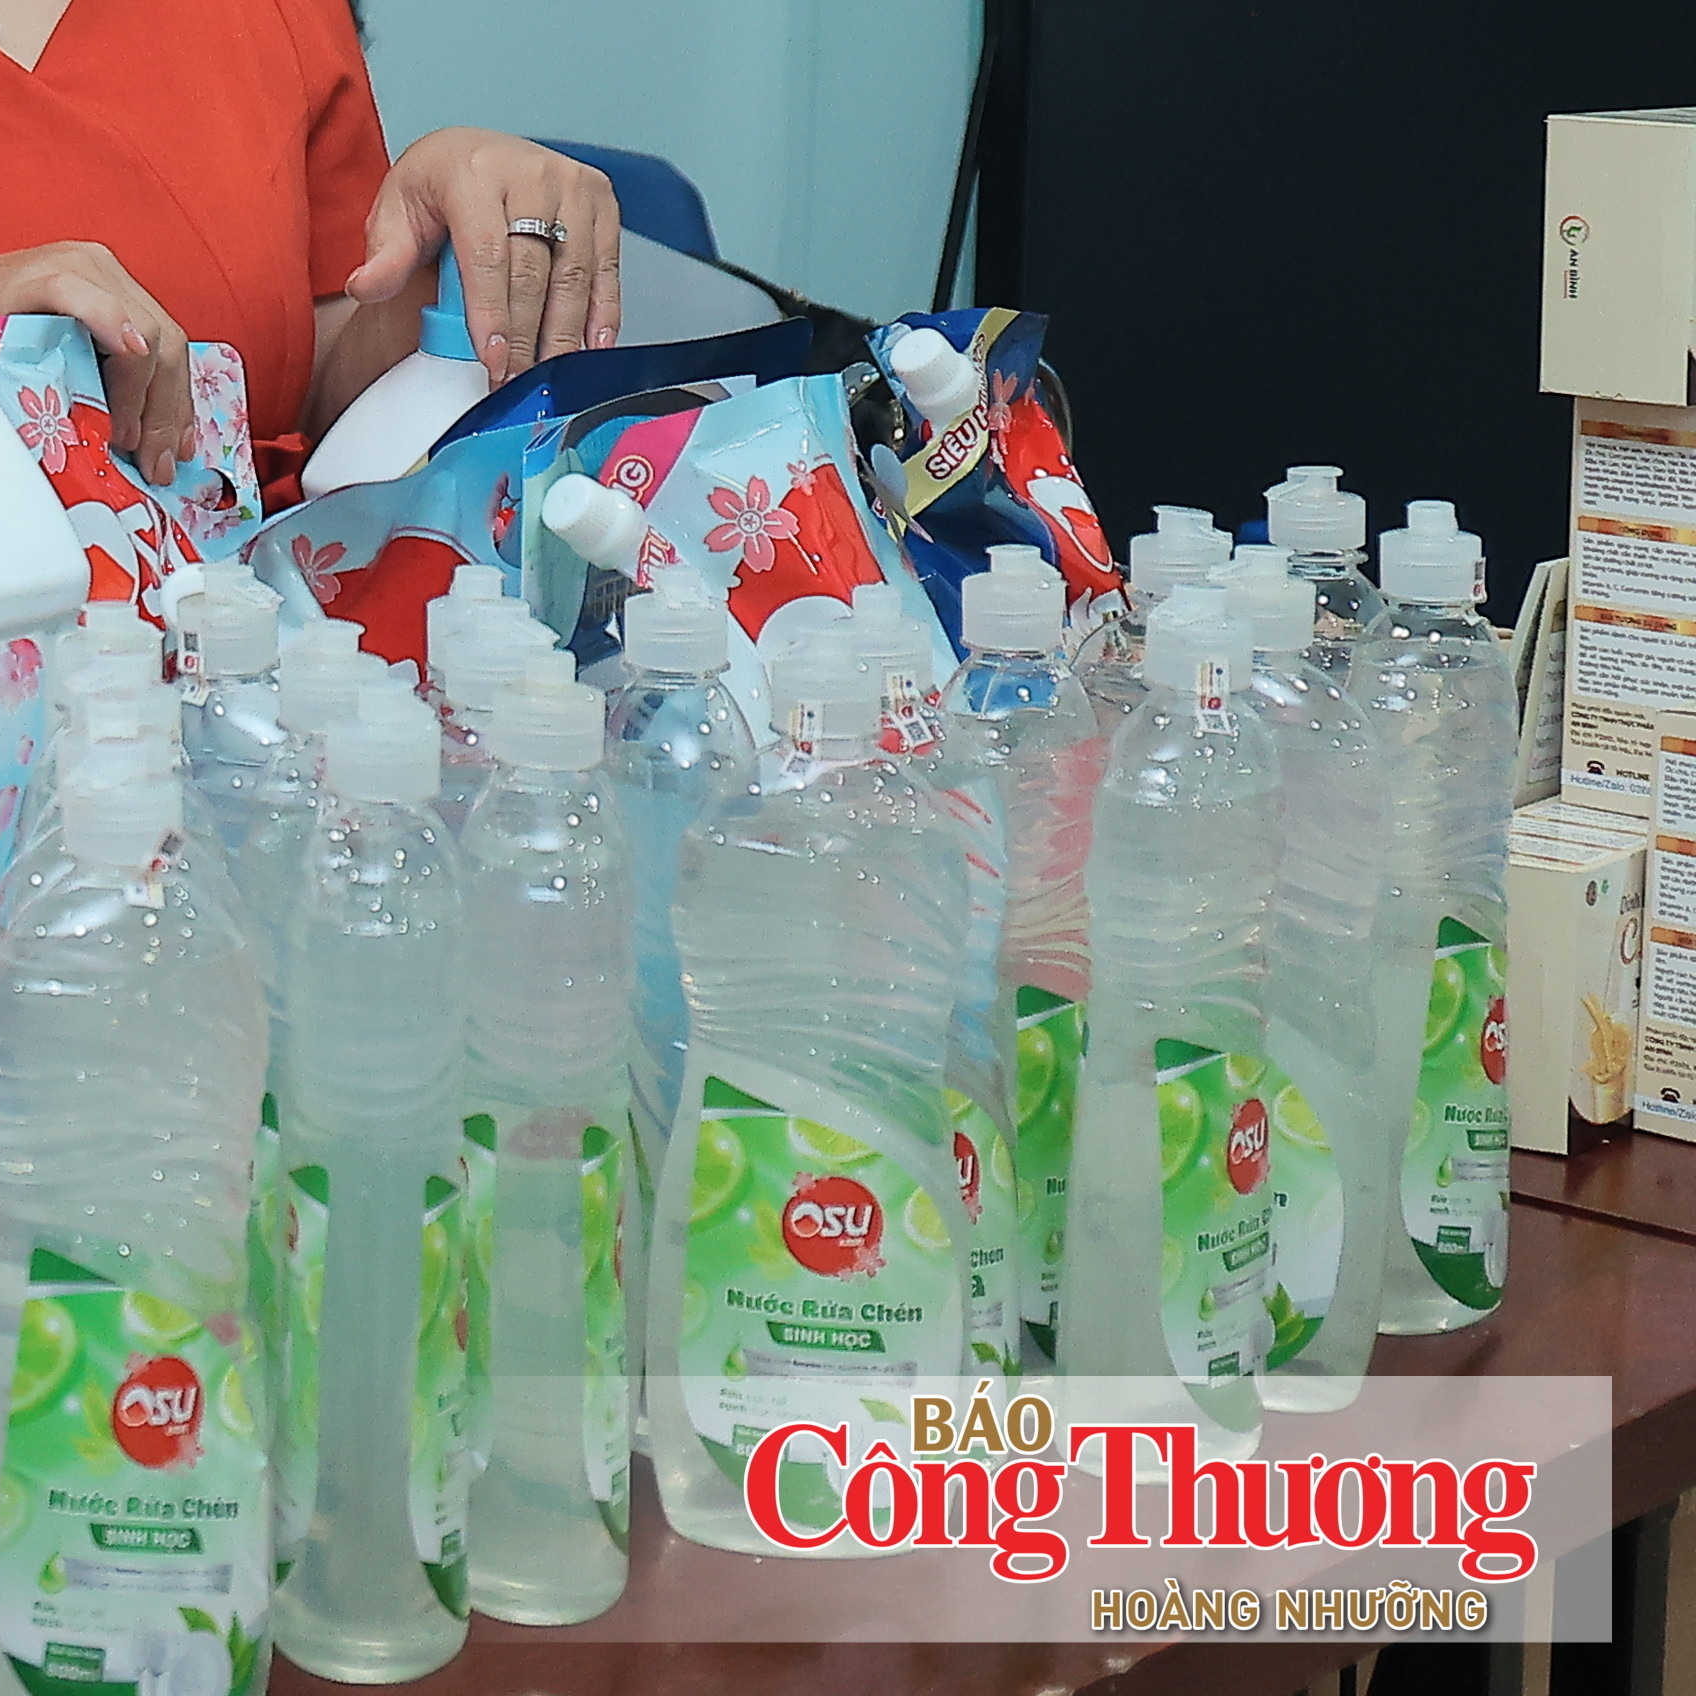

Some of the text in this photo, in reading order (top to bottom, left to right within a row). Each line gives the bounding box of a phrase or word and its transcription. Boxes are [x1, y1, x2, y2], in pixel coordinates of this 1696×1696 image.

[925, 418, 979, 480] SIÊU
[790, 1201, 873, 1238] OSU
[725, 1287, 925, 1323] Nước Rửa Chén
